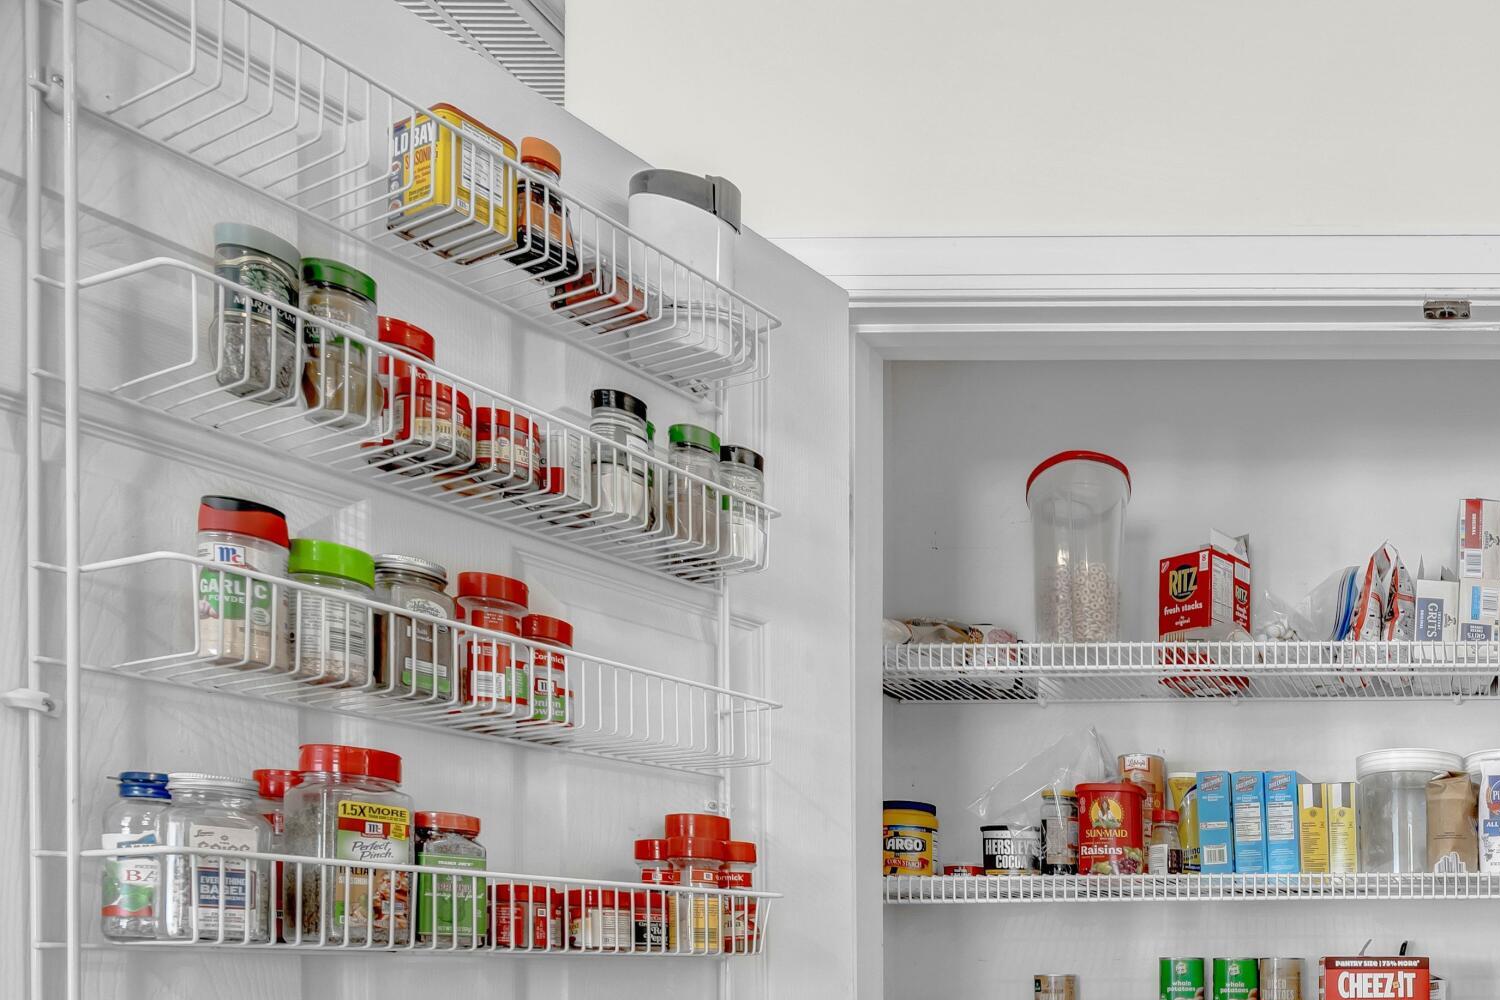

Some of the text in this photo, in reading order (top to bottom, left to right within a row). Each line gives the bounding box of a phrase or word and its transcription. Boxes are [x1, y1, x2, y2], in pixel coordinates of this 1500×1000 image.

[200, 578, 267, 599] GARLC
[1168, 566, 1198, 597] RITZ
[1235, 586, 1248, 603] RITZ
[1163, 601, 1203, 617] fresh stacks
[1426, 603, 1438, 638] GRITS
[340, 802, 408, 818] 1.5X MORE
[351, 840, 392, 852] Perfect
[886, 837, 925, 853] ARGO
[1080, 844, 1123, 856] Raisins
[199, 876, 248, 886] EVERTHING
[199, 884, 247, 895] BAGEL
[1335, 960, 1364, 968] PANTRY
[1382, 960, 1398, 968] 75%
